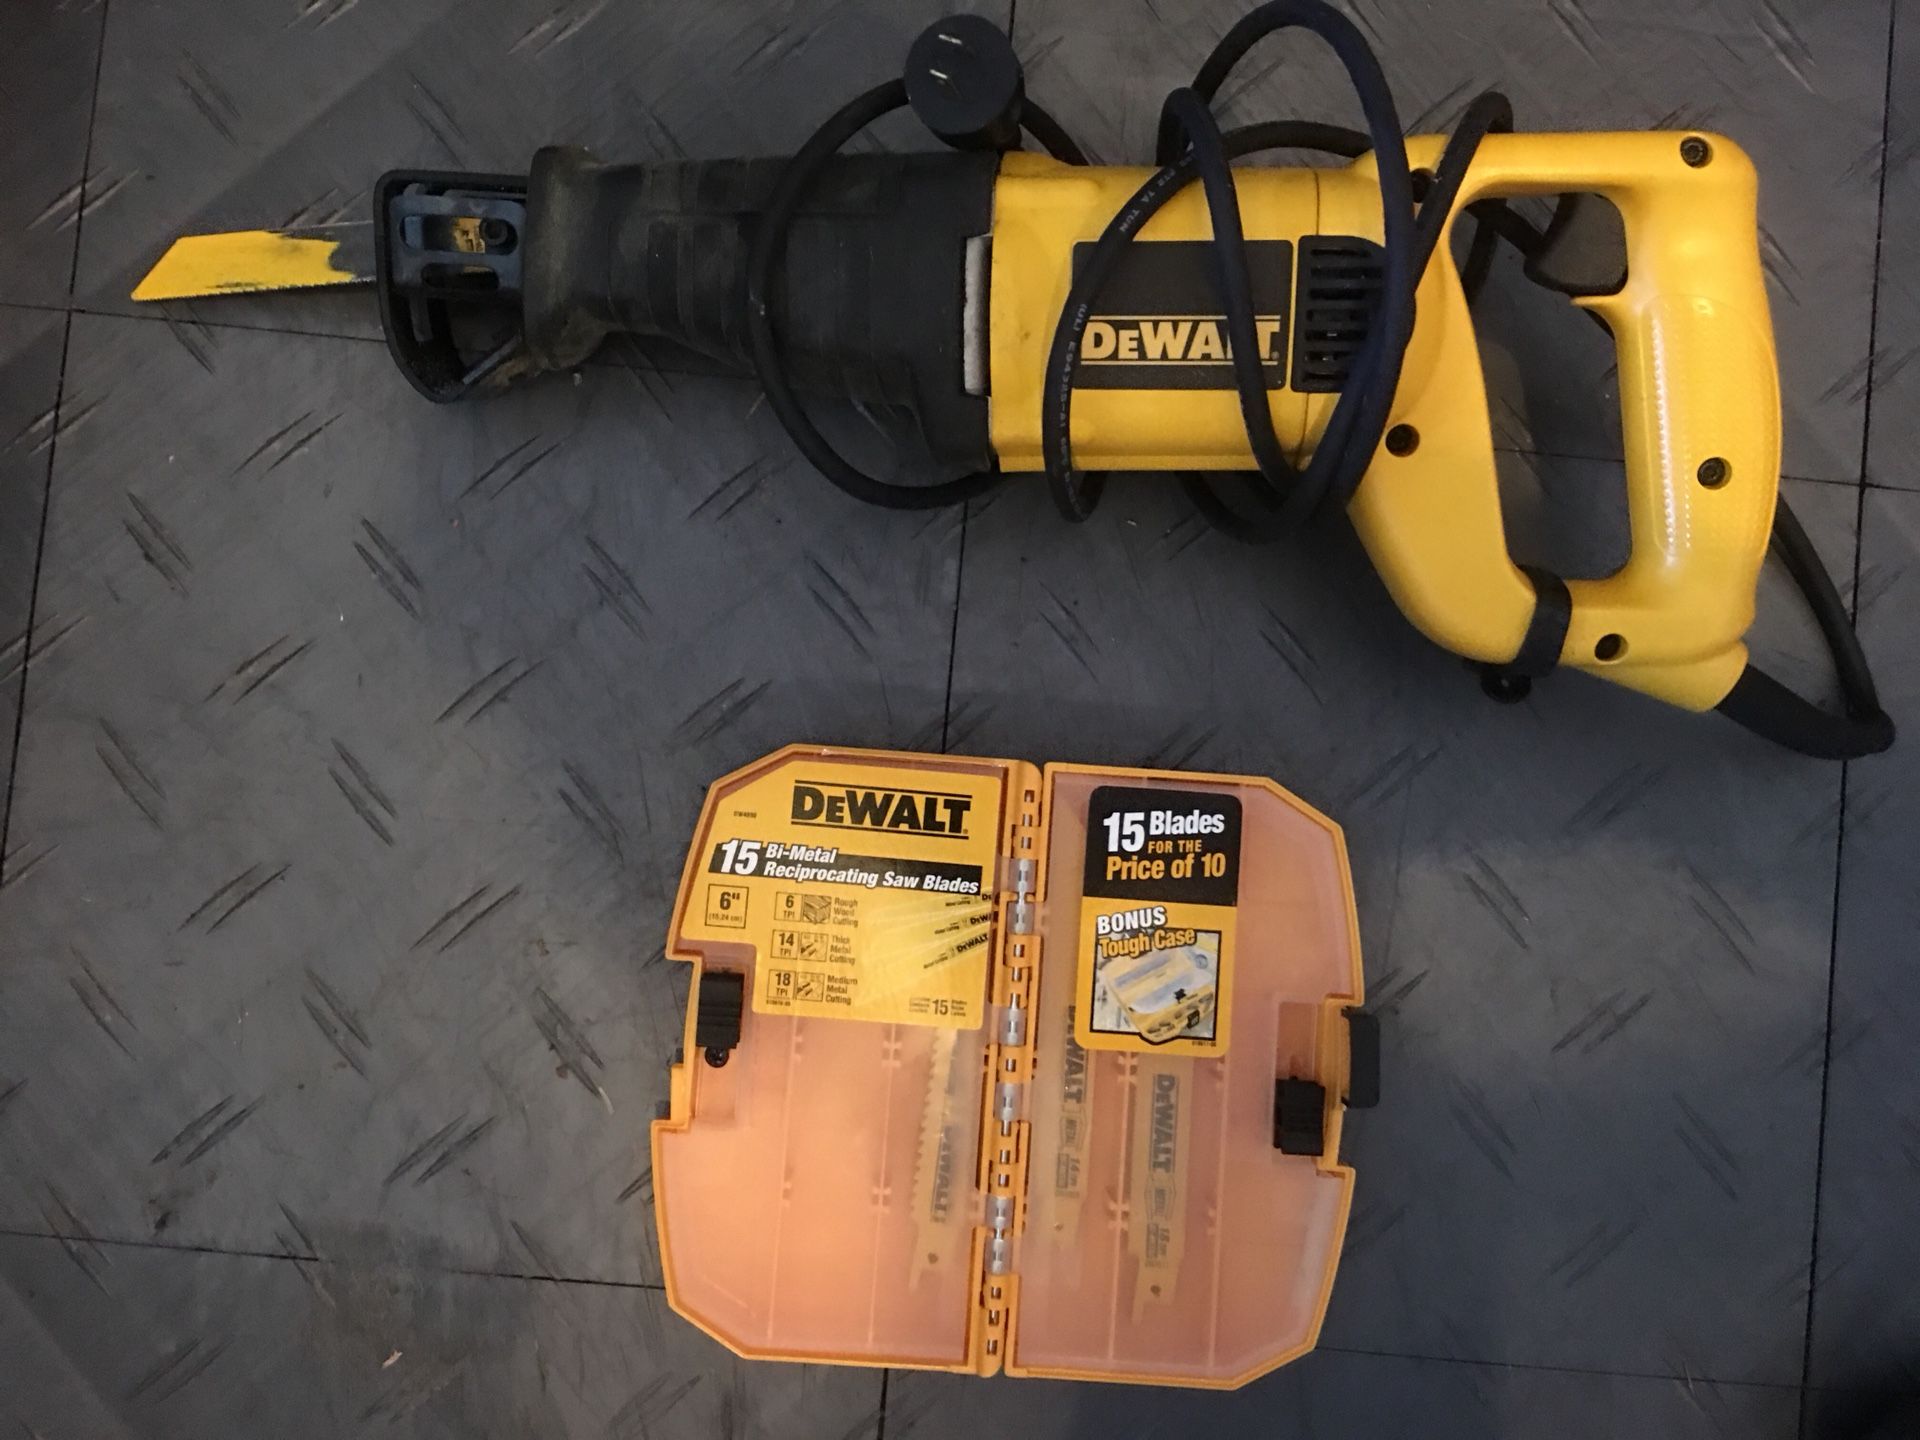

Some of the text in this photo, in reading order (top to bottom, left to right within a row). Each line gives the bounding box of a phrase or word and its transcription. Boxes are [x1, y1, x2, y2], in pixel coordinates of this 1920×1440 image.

[1081, 321, 1280, 360] DEWAT
[791, 785, 972, 834] DEWALT
[1103, 809, 1225, 852] 15 Blades
[1147, 839, 1203, 854] FOR THE
[721, 839, 838, 876] 15 Bi-Metal
[1106, 852, 1227, 881] Price of 10
[763, 861, 980, 895] Reciprocating Saw Blades
[719, 892, 741, 911] 6"
[785, 895, 795, 909] 6
[833, 897, 859, 909] Rough
[783, 910, 796, 919] TPI
[833, 907, 856, 917] Wood
[832, 917, 859, 929] Cutting
[1097, 906, 1167, 935] BONUS
[778, 932, 795, 947] 14
[1099, 928, 1197, 958] Tough Case
[780, 947, 792, 957] TPI
[829, 944, 852, 955] Metal
[829, 954, 856, 966] Cutting
[775, 972, 791, 987] 18
[827, 975, 858, 985] Medium
[775, 987, 788, 997] TPI
[826, 984, 848, 994] Metal
[825, 994, 852, 1006] Cutting
[931, 999, 949, 1016] 15
[1152, 1073, 1176, 1174] DEWALT
